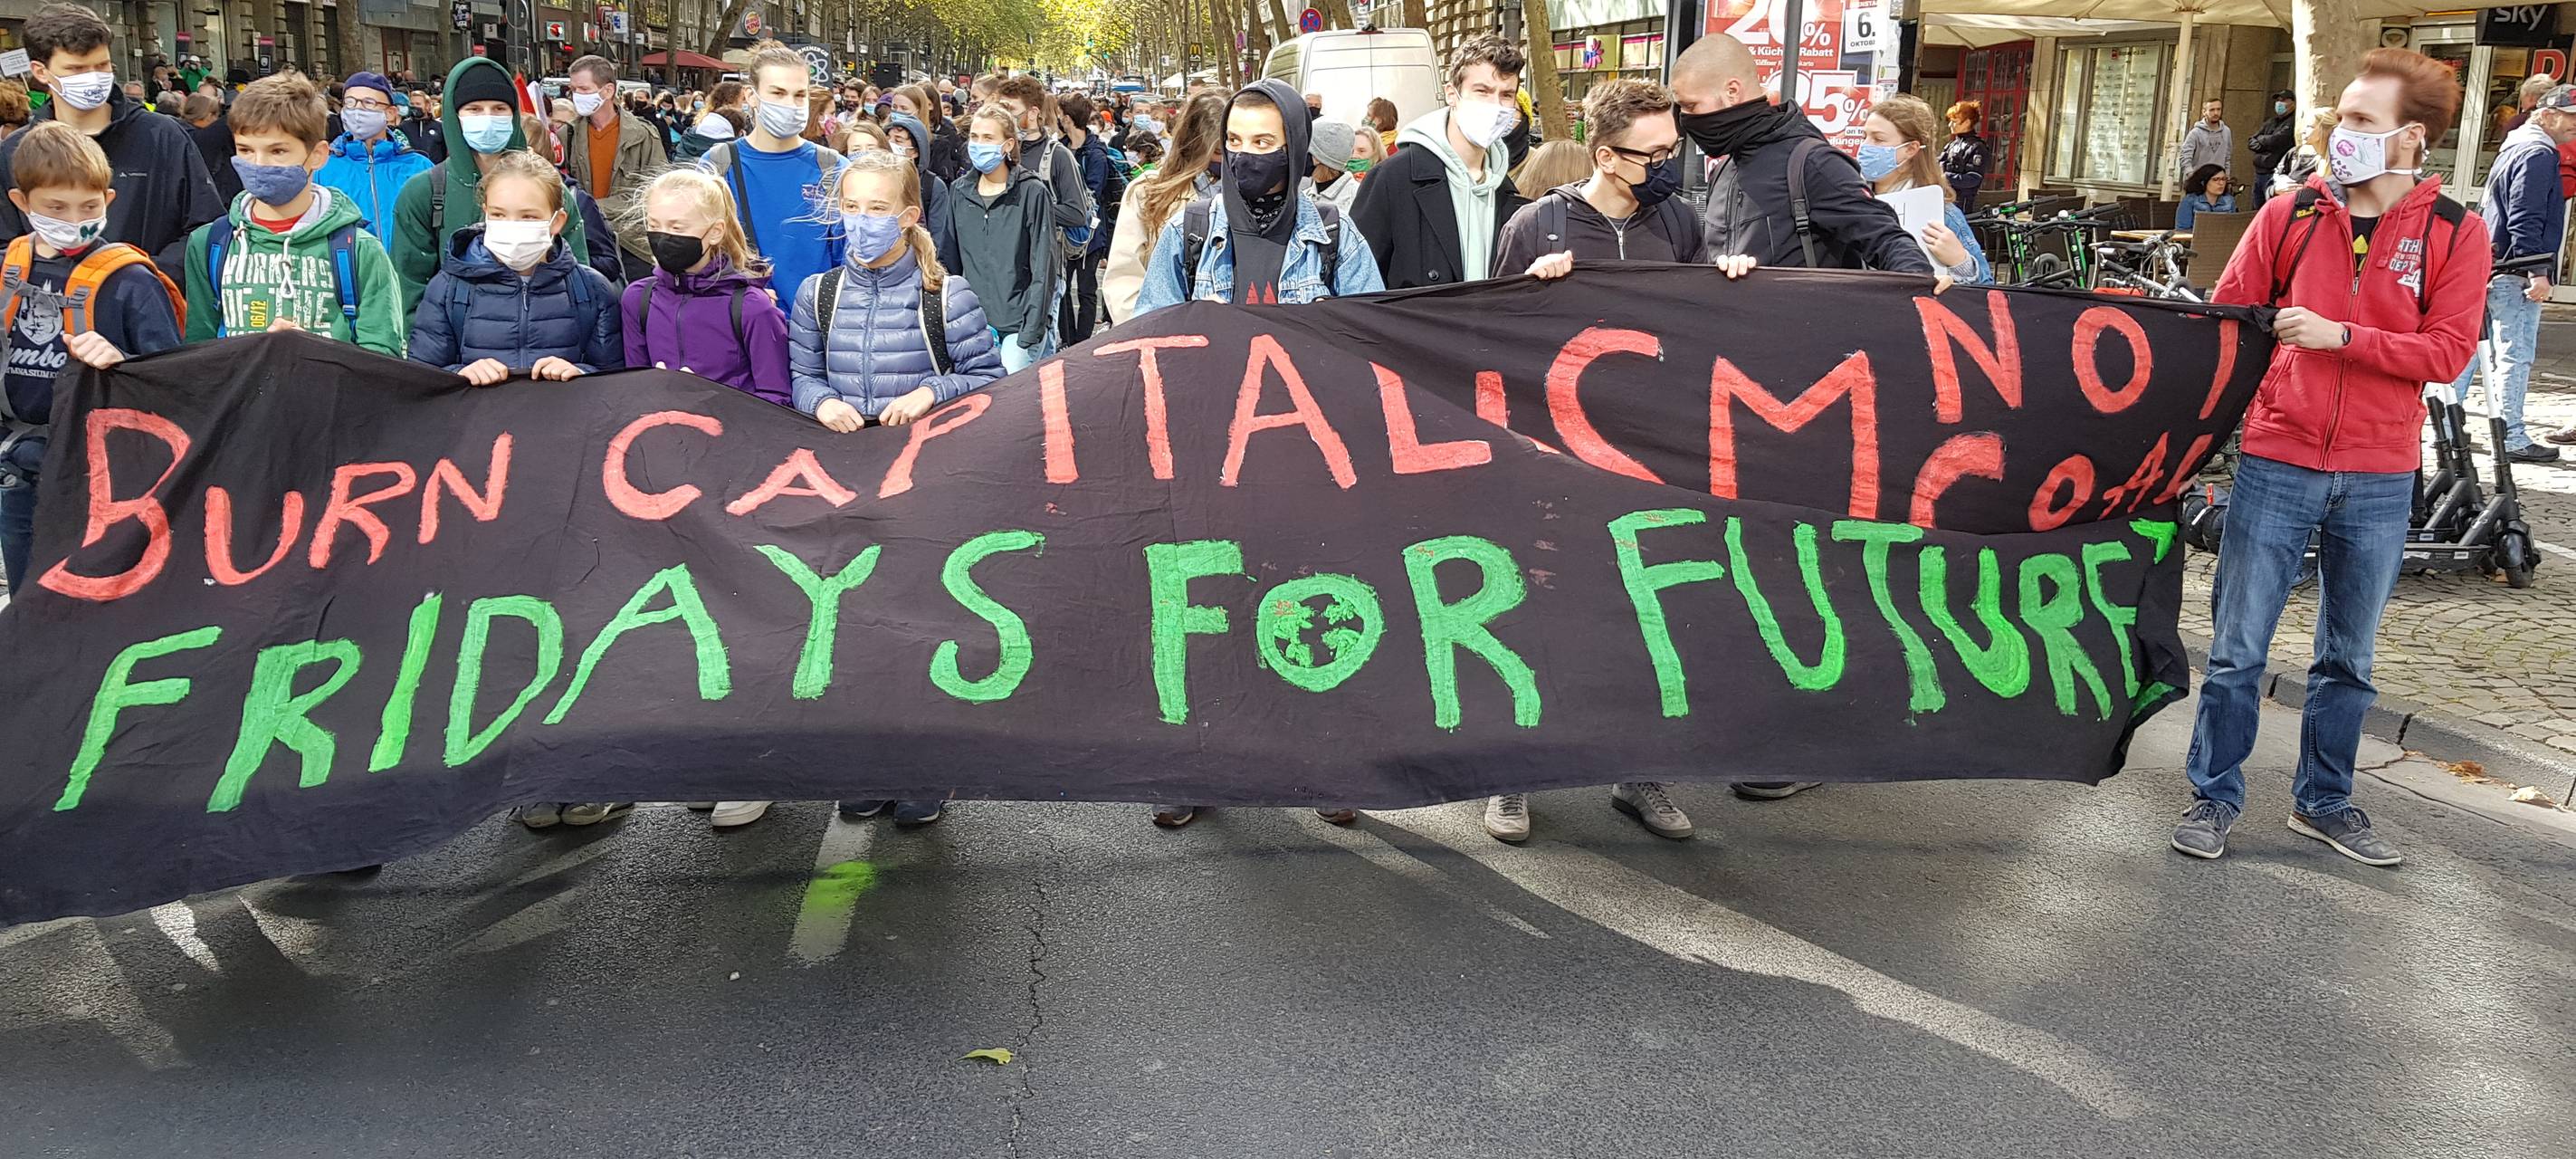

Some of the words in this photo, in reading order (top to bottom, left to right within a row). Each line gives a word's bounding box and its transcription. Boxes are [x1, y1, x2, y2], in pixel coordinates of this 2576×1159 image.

[38, 408, 513, 602] BURN
[52, 530, 1045, 813] FRIDAYS
[1143, 535, 1542, 730] FOR
[1608, 509, 2147, 724] FUTURE
